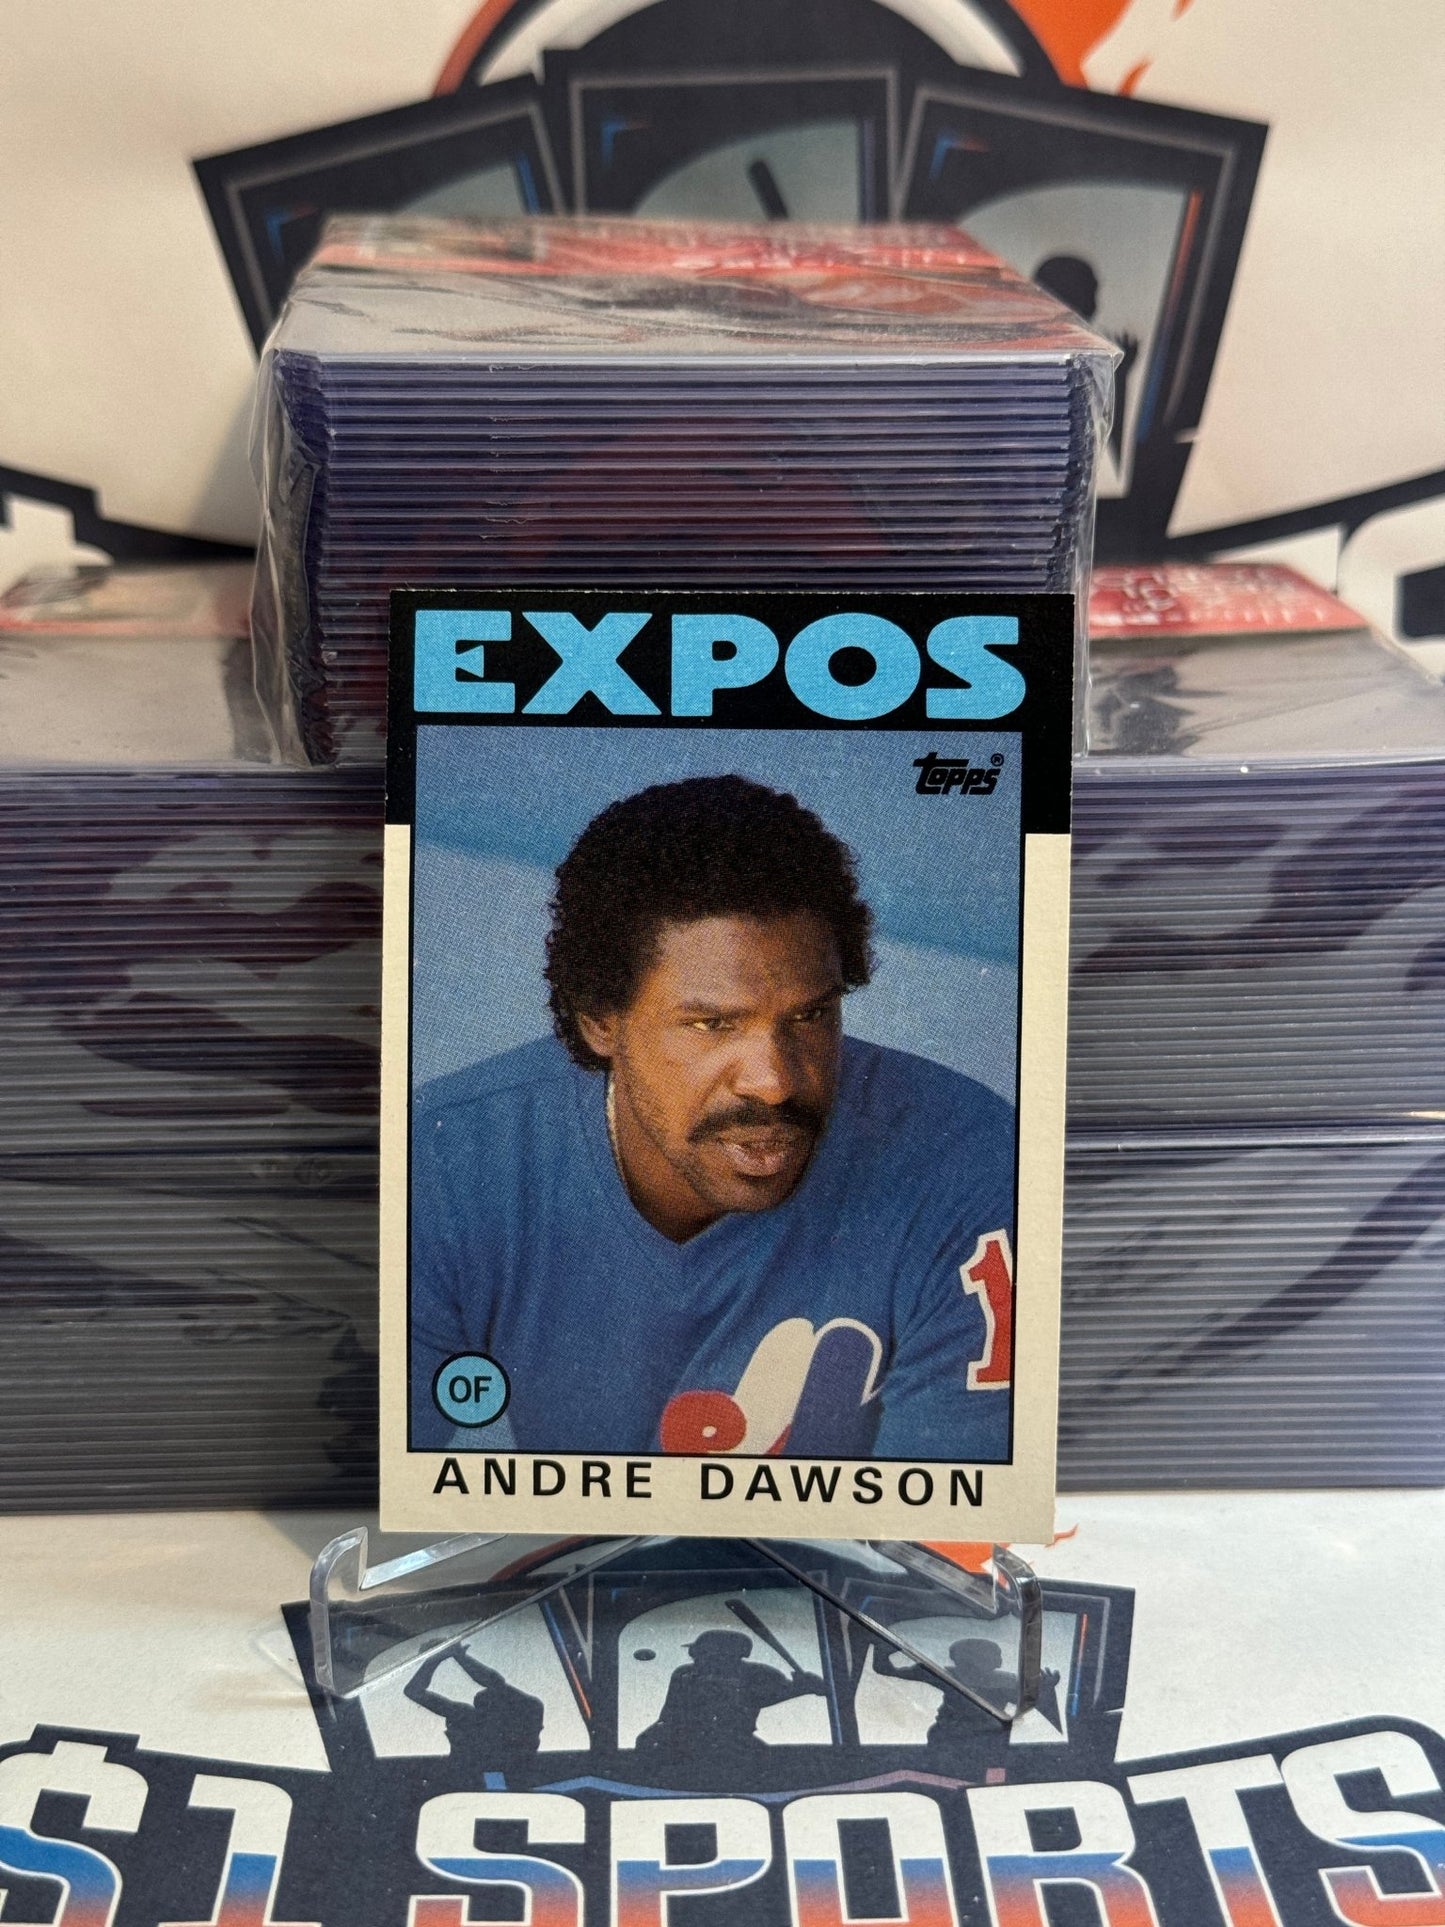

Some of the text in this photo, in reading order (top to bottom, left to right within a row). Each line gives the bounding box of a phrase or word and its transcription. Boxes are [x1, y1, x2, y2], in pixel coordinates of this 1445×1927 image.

[413, 610, 1027, 721] EXPOS
[448, 1375, 493, 1404] OF
[432, 1457, 984, 1507] ANDRE DAWSON
[405, 1730, 1445, 1927] SPORTS
